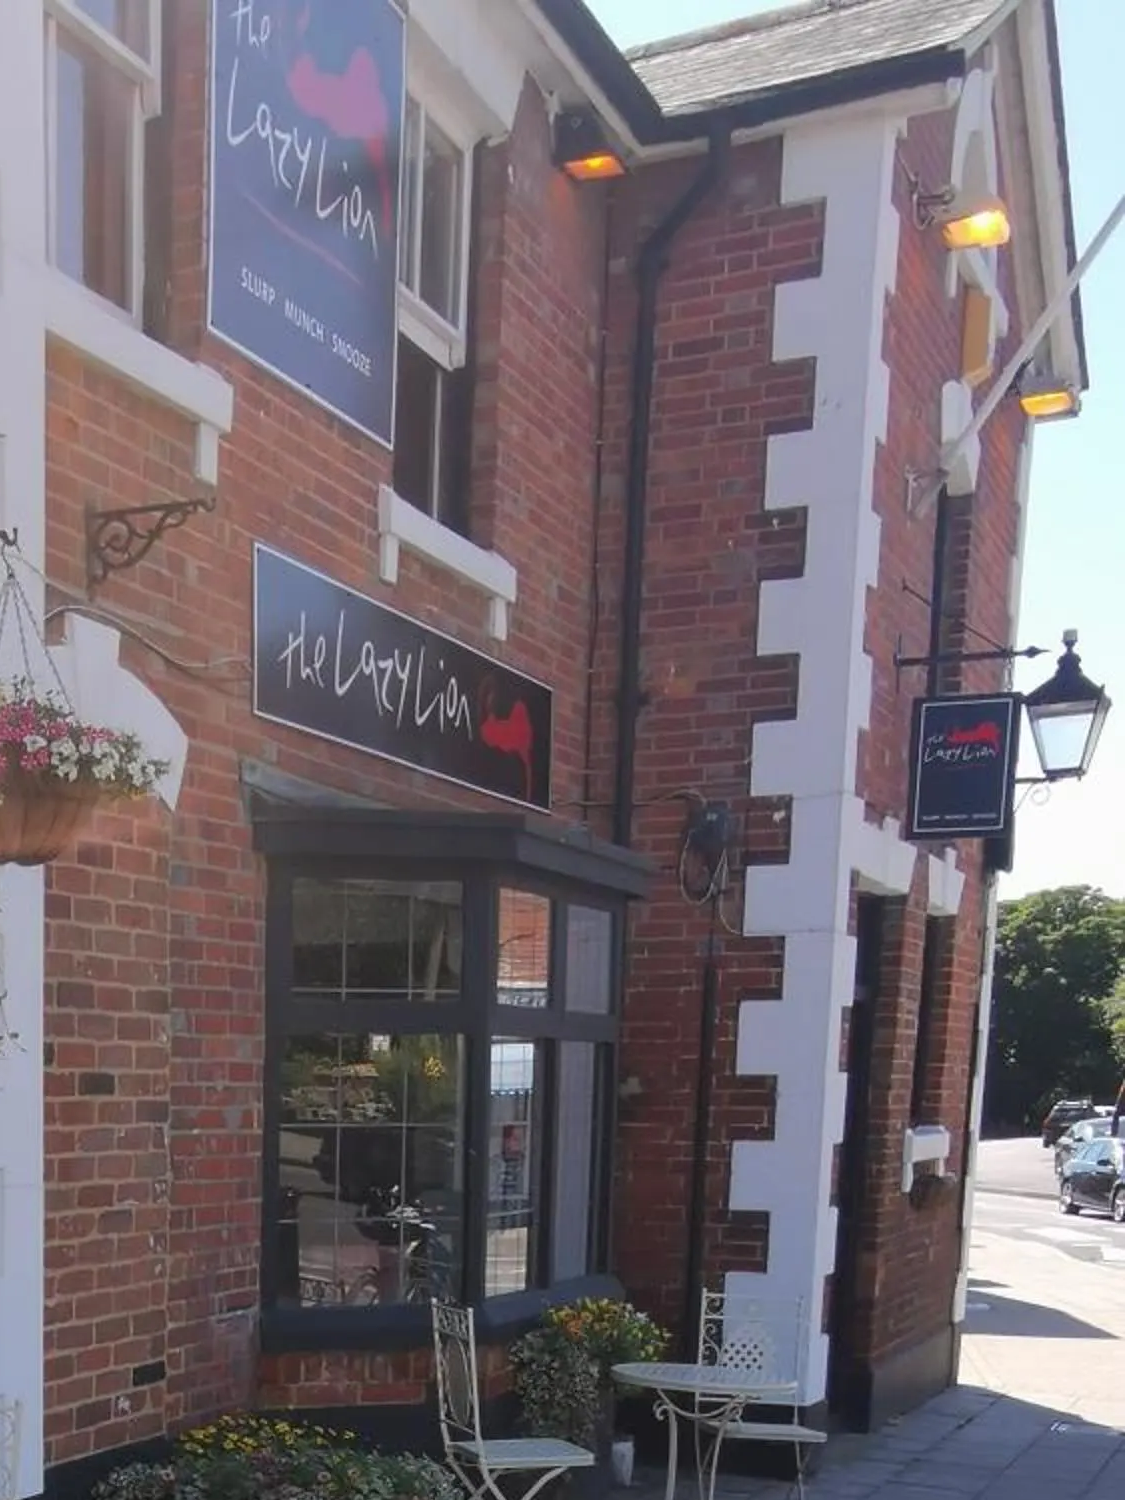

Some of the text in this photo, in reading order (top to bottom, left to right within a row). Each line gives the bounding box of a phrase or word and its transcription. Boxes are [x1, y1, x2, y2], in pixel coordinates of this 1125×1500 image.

[228, 0, 271, 58] the
[241, 266, 371, 376] SLURP MUNCH SNOOZE
[278, 610, 325, 688] the
